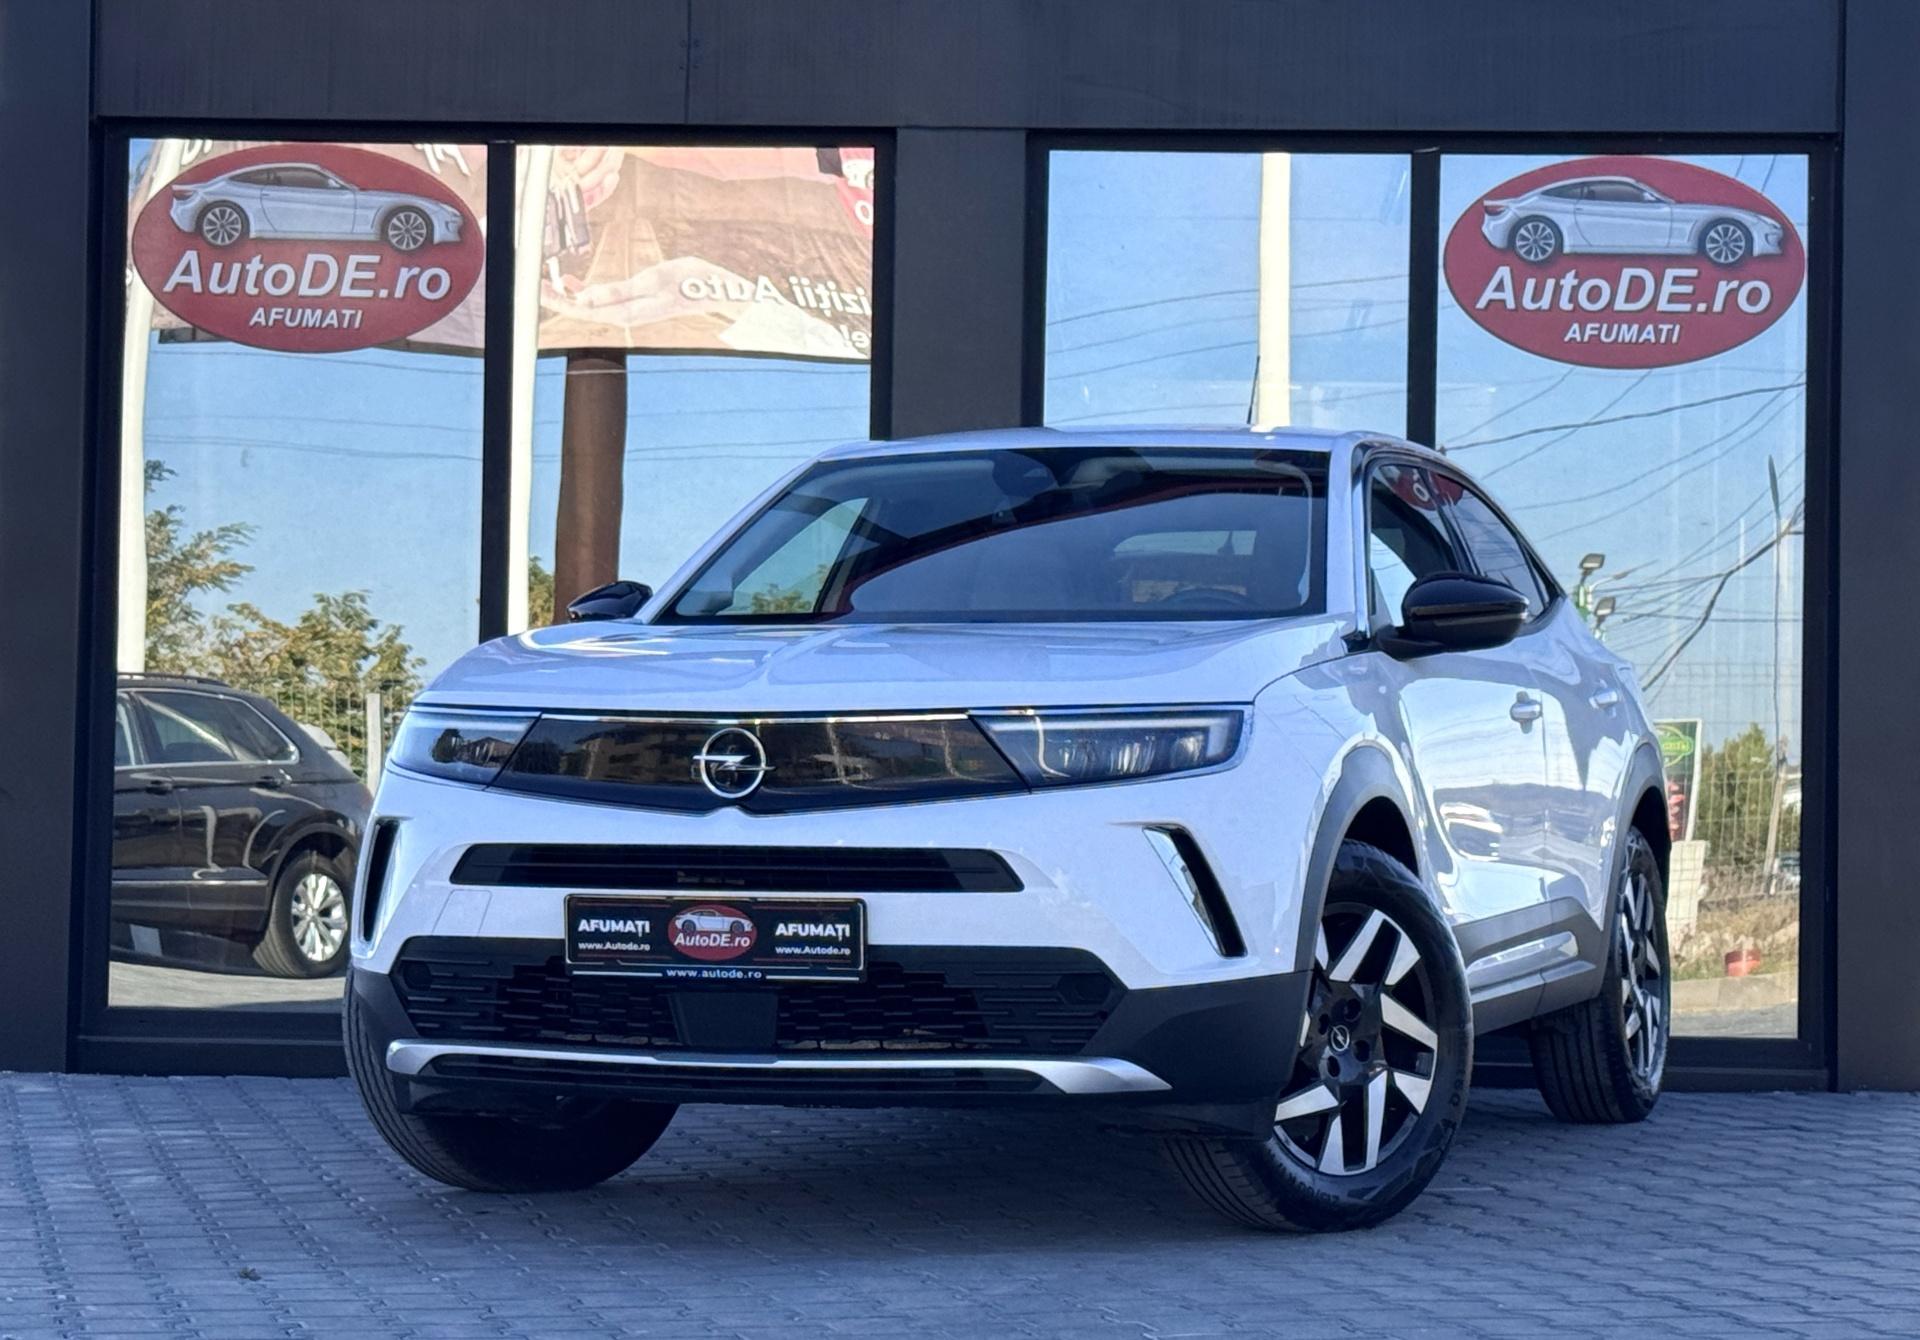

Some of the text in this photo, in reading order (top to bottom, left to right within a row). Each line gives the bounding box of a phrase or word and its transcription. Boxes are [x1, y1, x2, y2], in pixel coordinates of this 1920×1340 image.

[163, 250, 451, 300] AutoDE.ro
[1475, 266, 1773, 314] AutoDE.ro
[249, 307, 362, 329] AFUMATI
[1564, 322, 1681, 345] AFUMATI
[578, 942, 651, 951] www.Autode.ro
[674, 932, 751, 947] AutoDE.ro
[775, 946, 851, 956] www.Autode.ro
[666, 969, 762, 979] www.autode.ro
